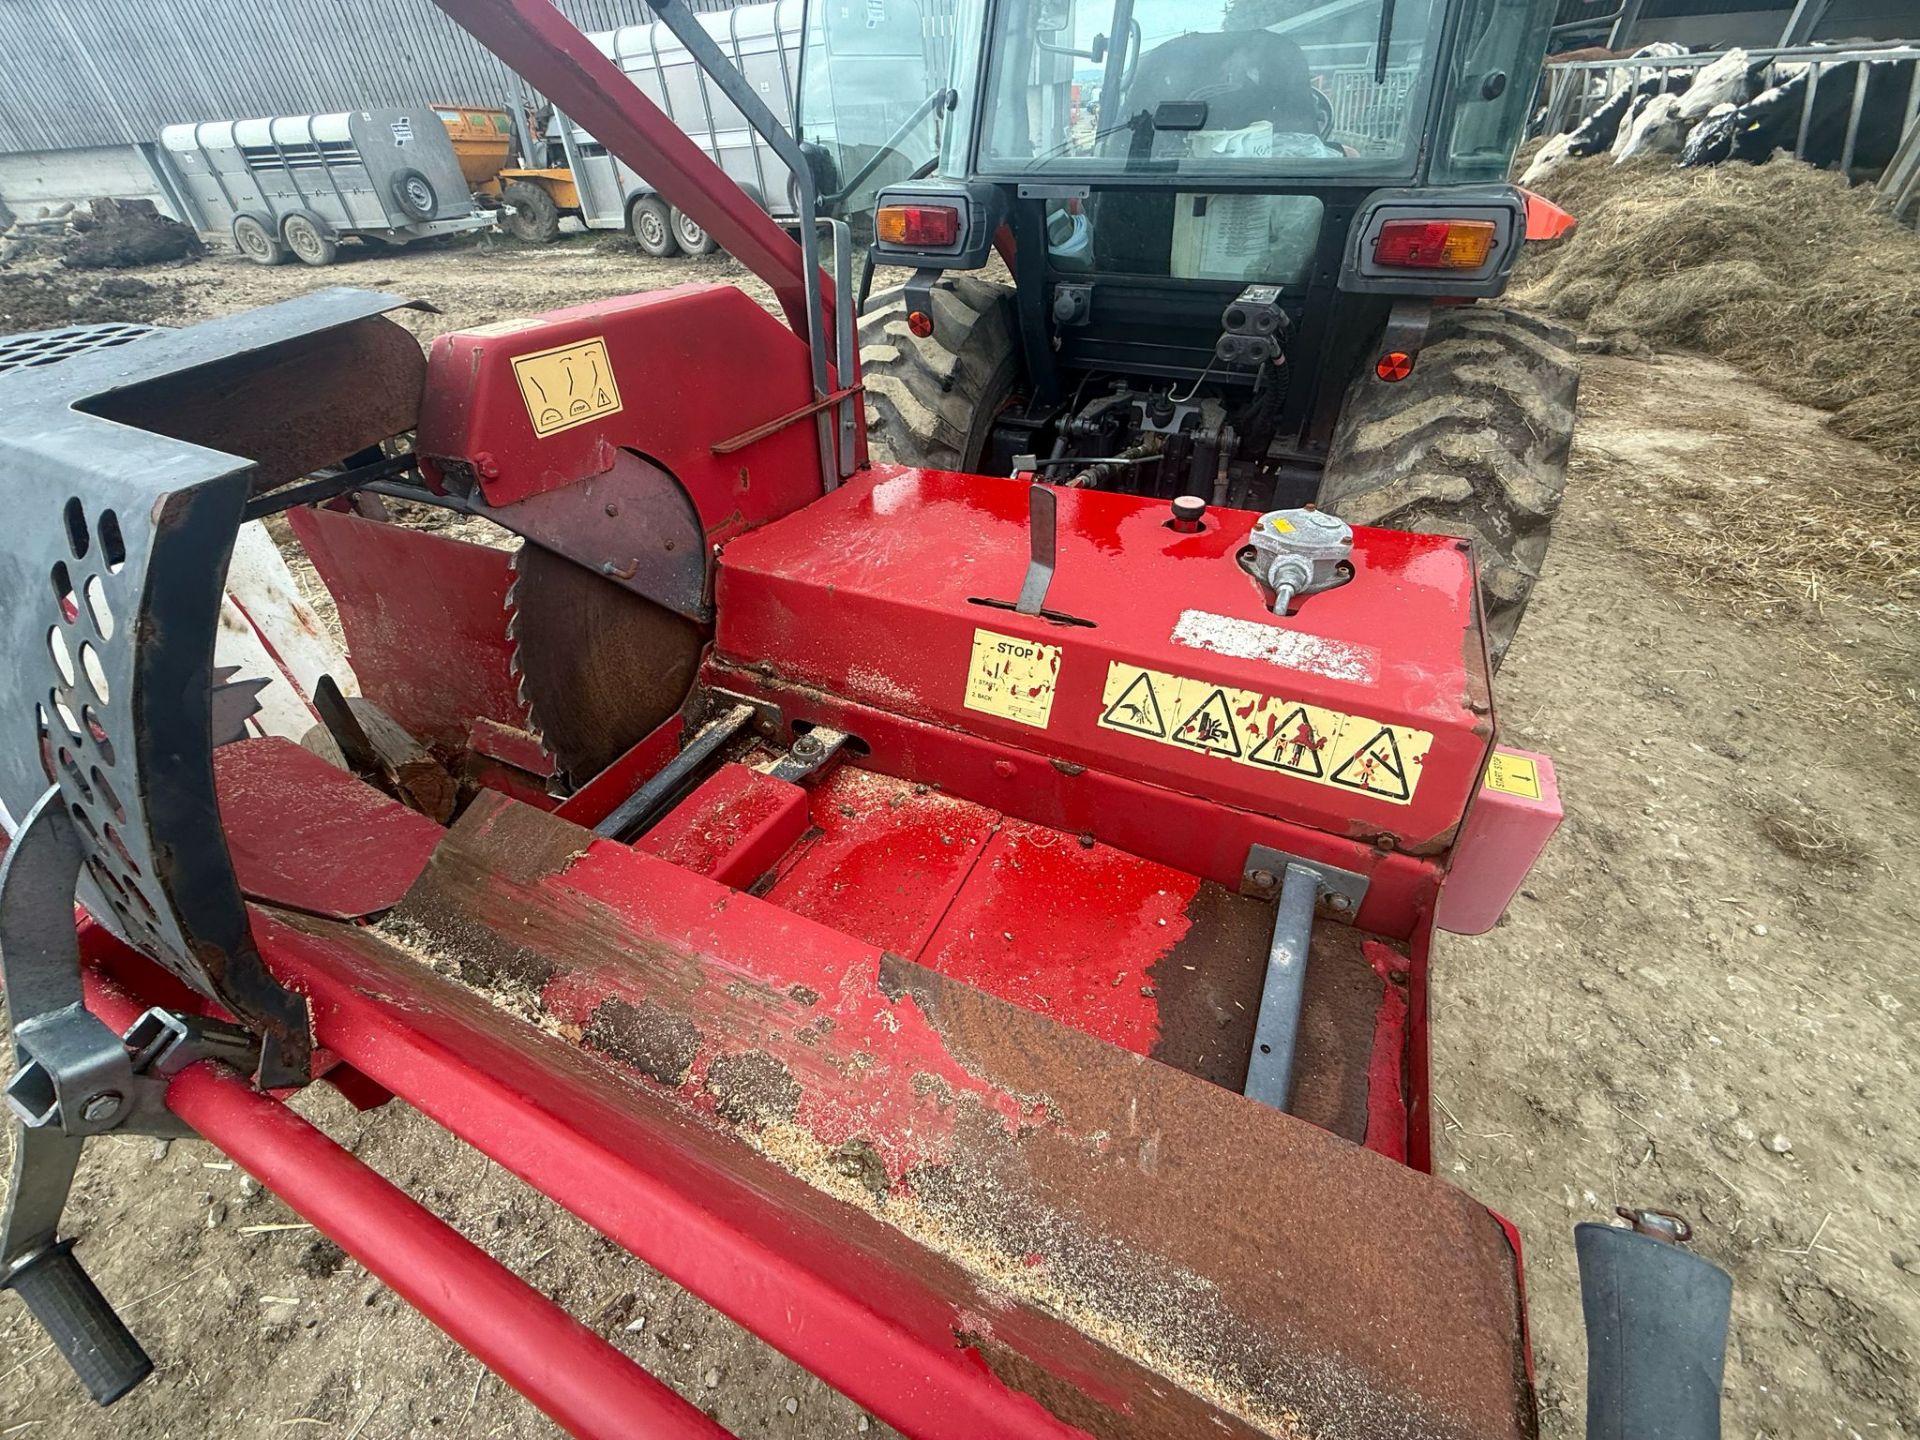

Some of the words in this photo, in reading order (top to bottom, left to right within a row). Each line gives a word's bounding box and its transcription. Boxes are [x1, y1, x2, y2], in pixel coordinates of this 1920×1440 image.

[573, 404, 586, 413] STOP
[996, 642, 1034, 659] STOP
[977, 693, 993, 702] BACK
